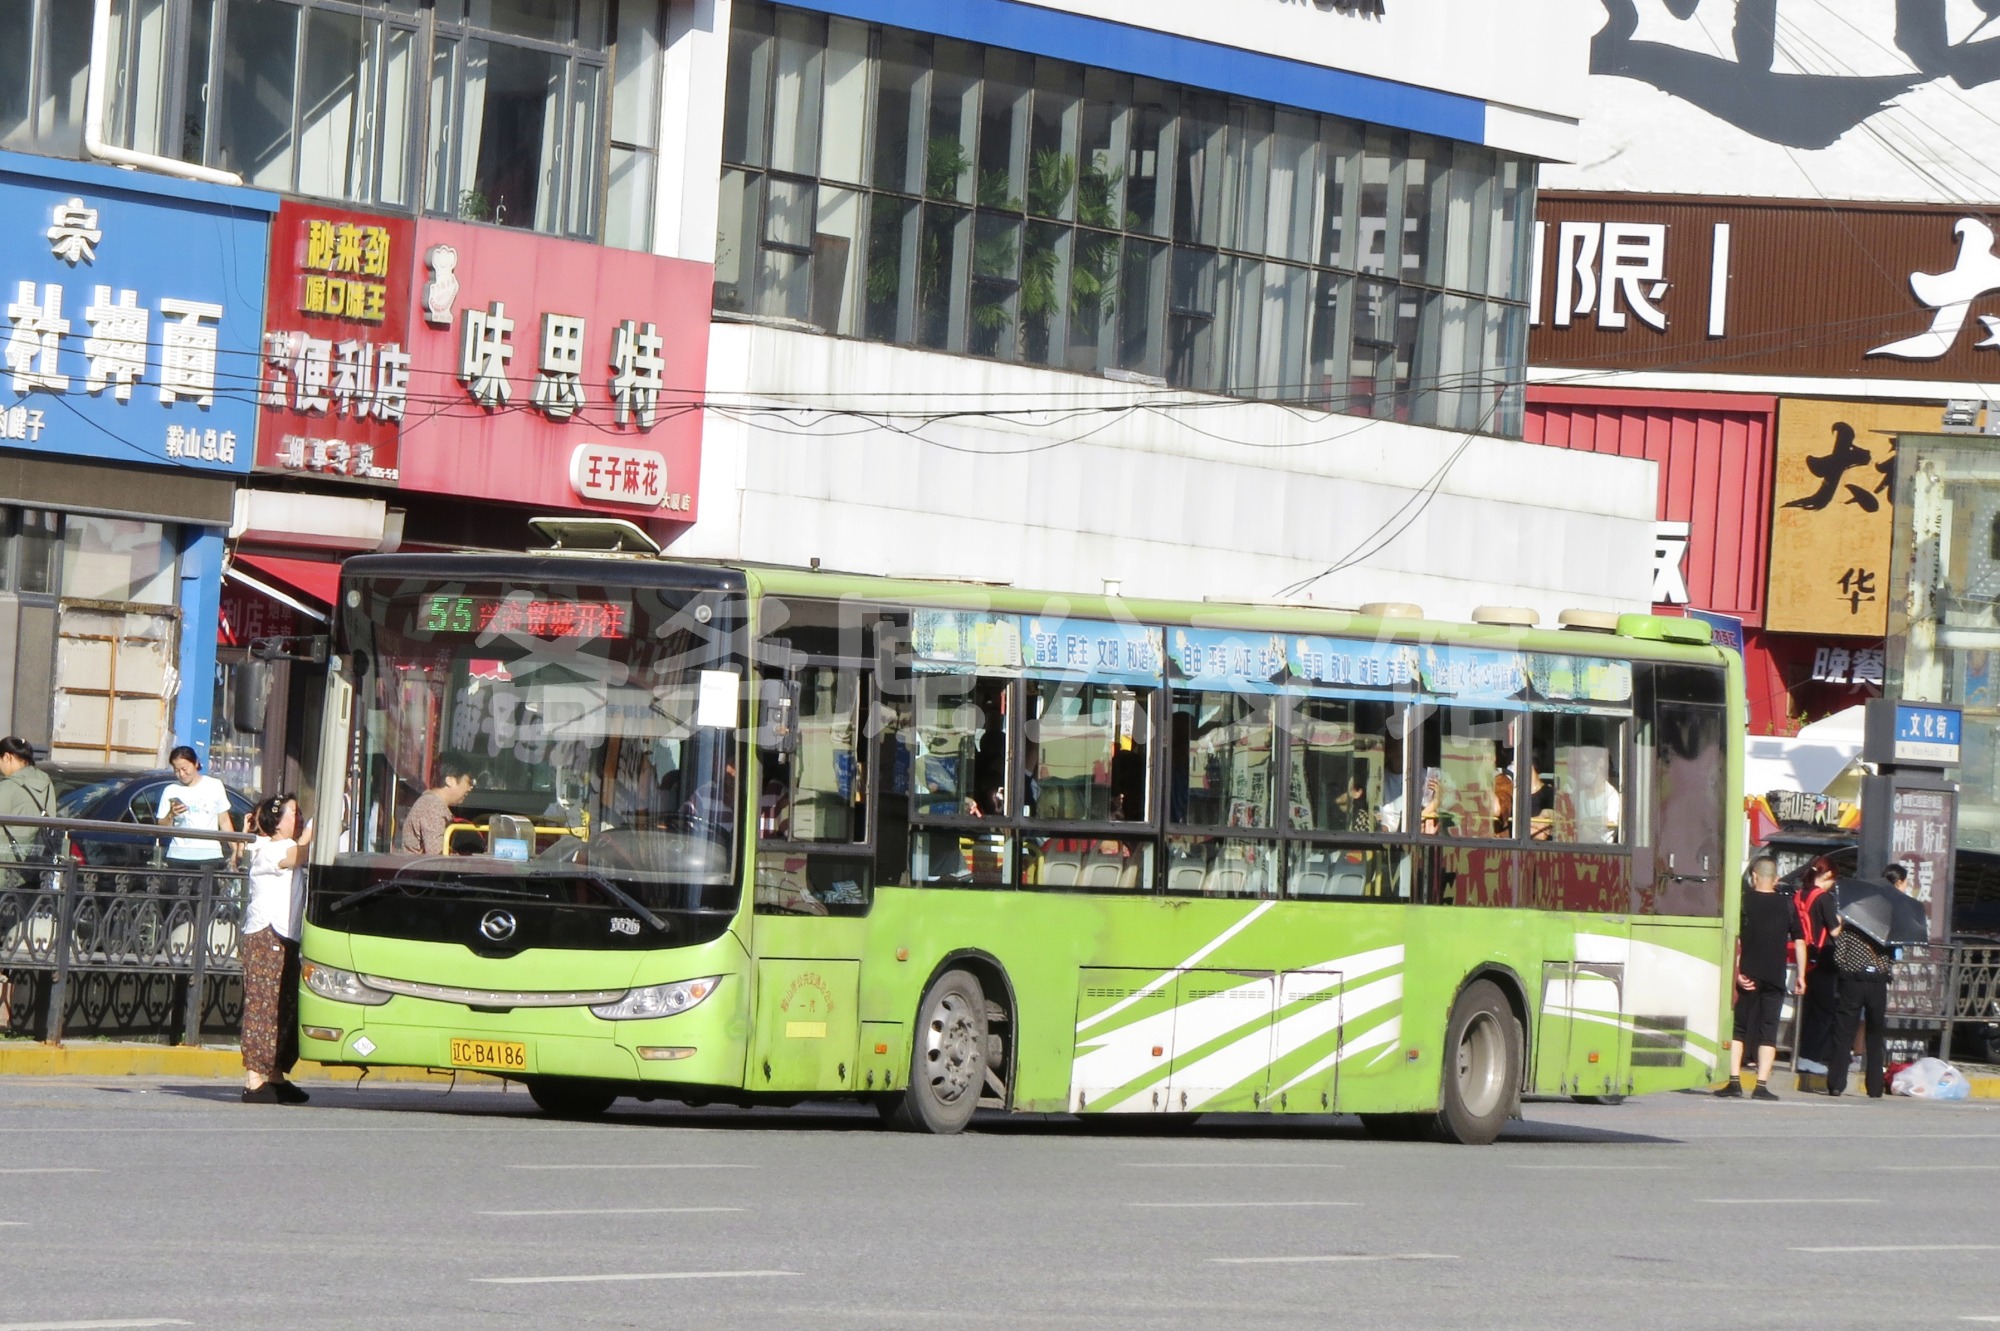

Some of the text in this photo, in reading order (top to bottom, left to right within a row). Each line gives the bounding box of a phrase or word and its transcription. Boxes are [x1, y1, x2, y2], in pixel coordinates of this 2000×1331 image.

[294, 332, 411, 420] 便利店
[458, 300, 665, 428] 味思特
[165, 424, 237, 464] 鞍山总店
[288, 435, 374, 476] 烟草专卖
[585, 455, 659, 496] 王子麻花
[1779, 421, 1898, 513] 大
[1836, 567, 1875, 615] 华
[428, 597, 473, 632] 55
[1035, 632, 1059, 665] 富强
[1066, 635, 1089, 666] 民主
[1096, 638, 1119, 669] 文明
[1126, 641, 1150, 671] 和谐
[1183, 644, 1281, 679] 自由 平等 公正 法治
[1302, 652, 1406, 686] 爱国 敬业 诚信 友善
[1812, 647, 1884, 686] 晚餐
[1909, 712, 1948, 739] 文化街
[1892, 819, 1948, 853] 种植 矫正
[609, 916, 641, 935] 黄海
[356, 1041, 373, 1051] LNG
